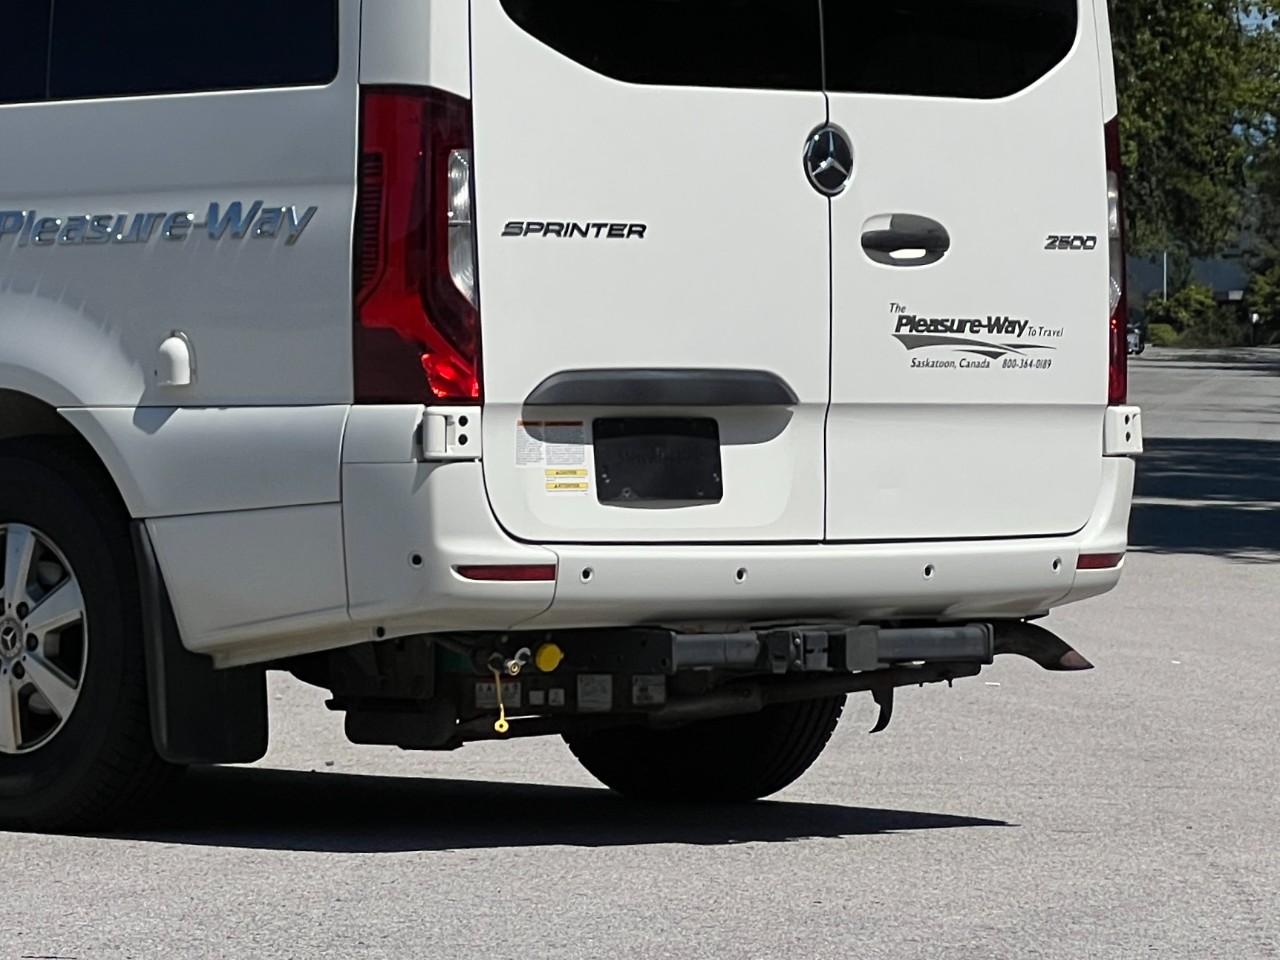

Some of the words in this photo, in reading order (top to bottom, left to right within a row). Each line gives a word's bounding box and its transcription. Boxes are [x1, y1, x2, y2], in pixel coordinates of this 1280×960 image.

[501, 221, 647, 239] SPRINTER
[1044, 235, 1097, 250] 2500
[890, 302, 906, 313] The
[895, 315, 1028, 337] Pleasure-Way
[1028, 326, 1037, 337] To
[1038, 326, 1064, 338] Travel
[910, 357, 957, 369] Saskatoon,
[959, 357, 991, 368] Canada
